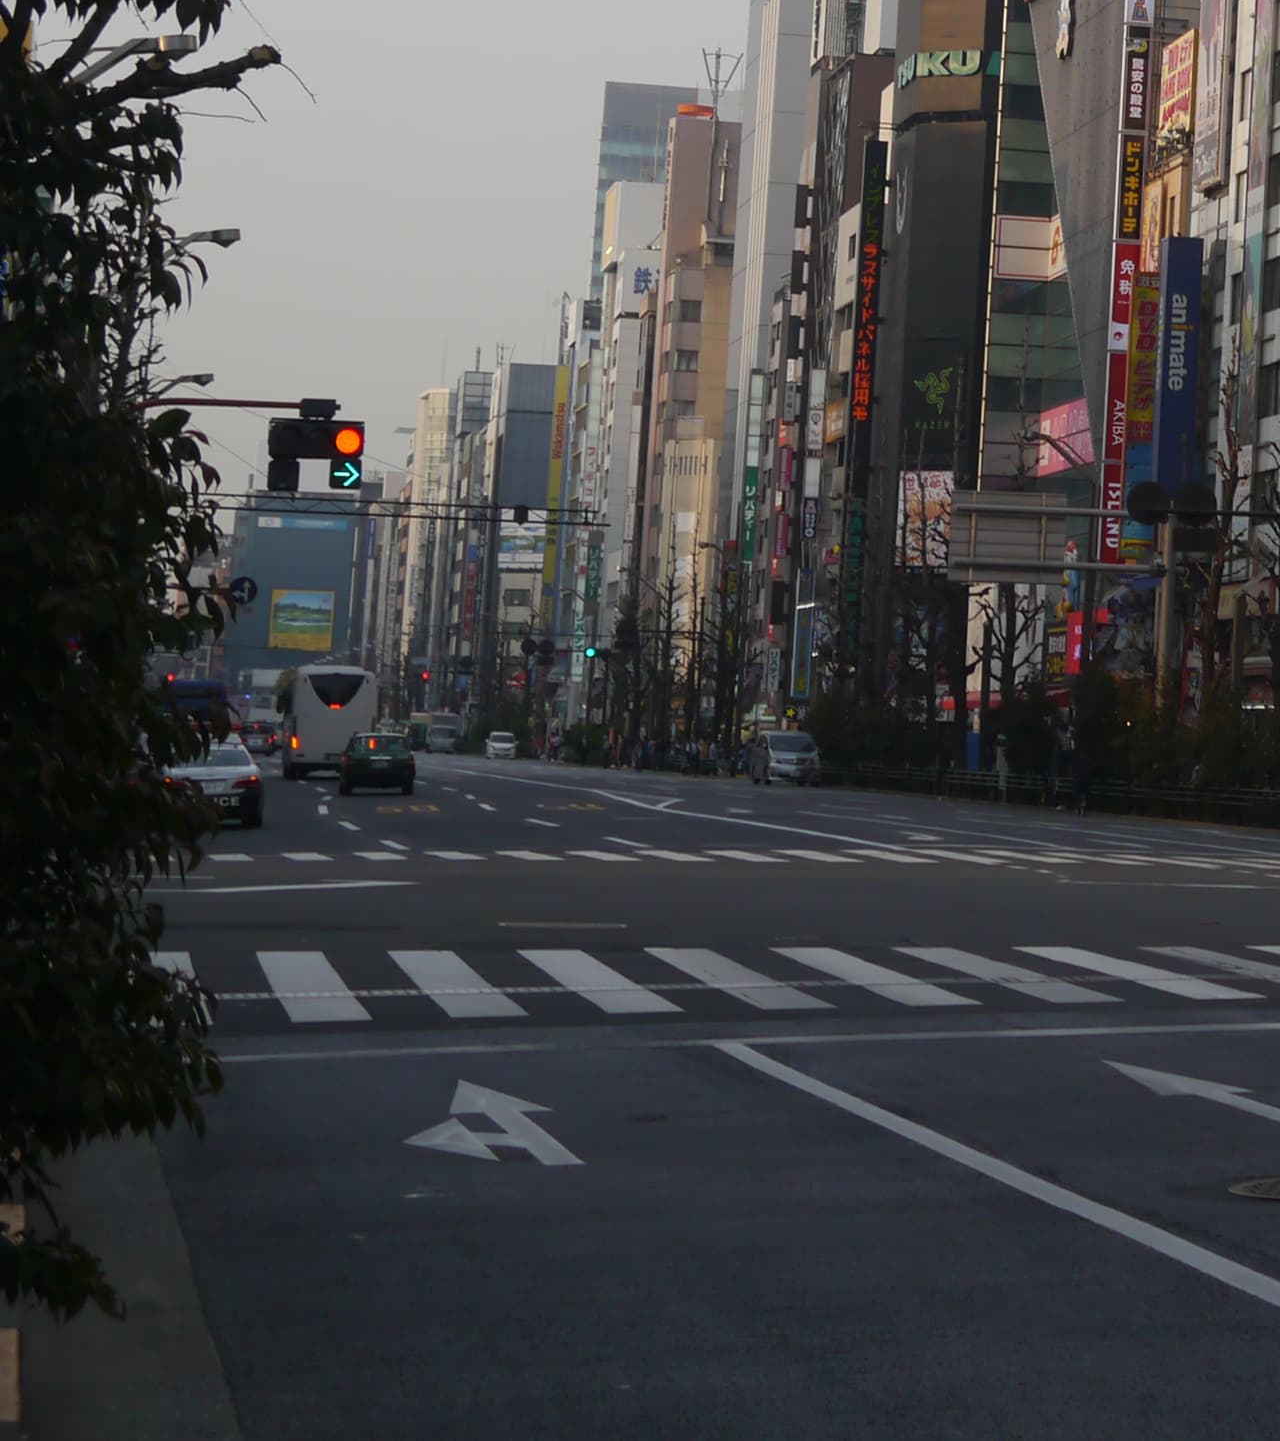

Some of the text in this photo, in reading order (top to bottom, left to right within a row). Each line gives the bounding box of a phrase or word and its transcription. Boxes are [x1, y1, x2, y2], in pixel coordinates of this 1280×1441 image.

[633, 266, 659, 295] 鉄
[1168, 293, 1195, 391] animate
[551, 402, 566, 460] Wakamatsu
[1112, 399, 1127, 447] AKIBA
[744, 484, 757, 542] リバティー
